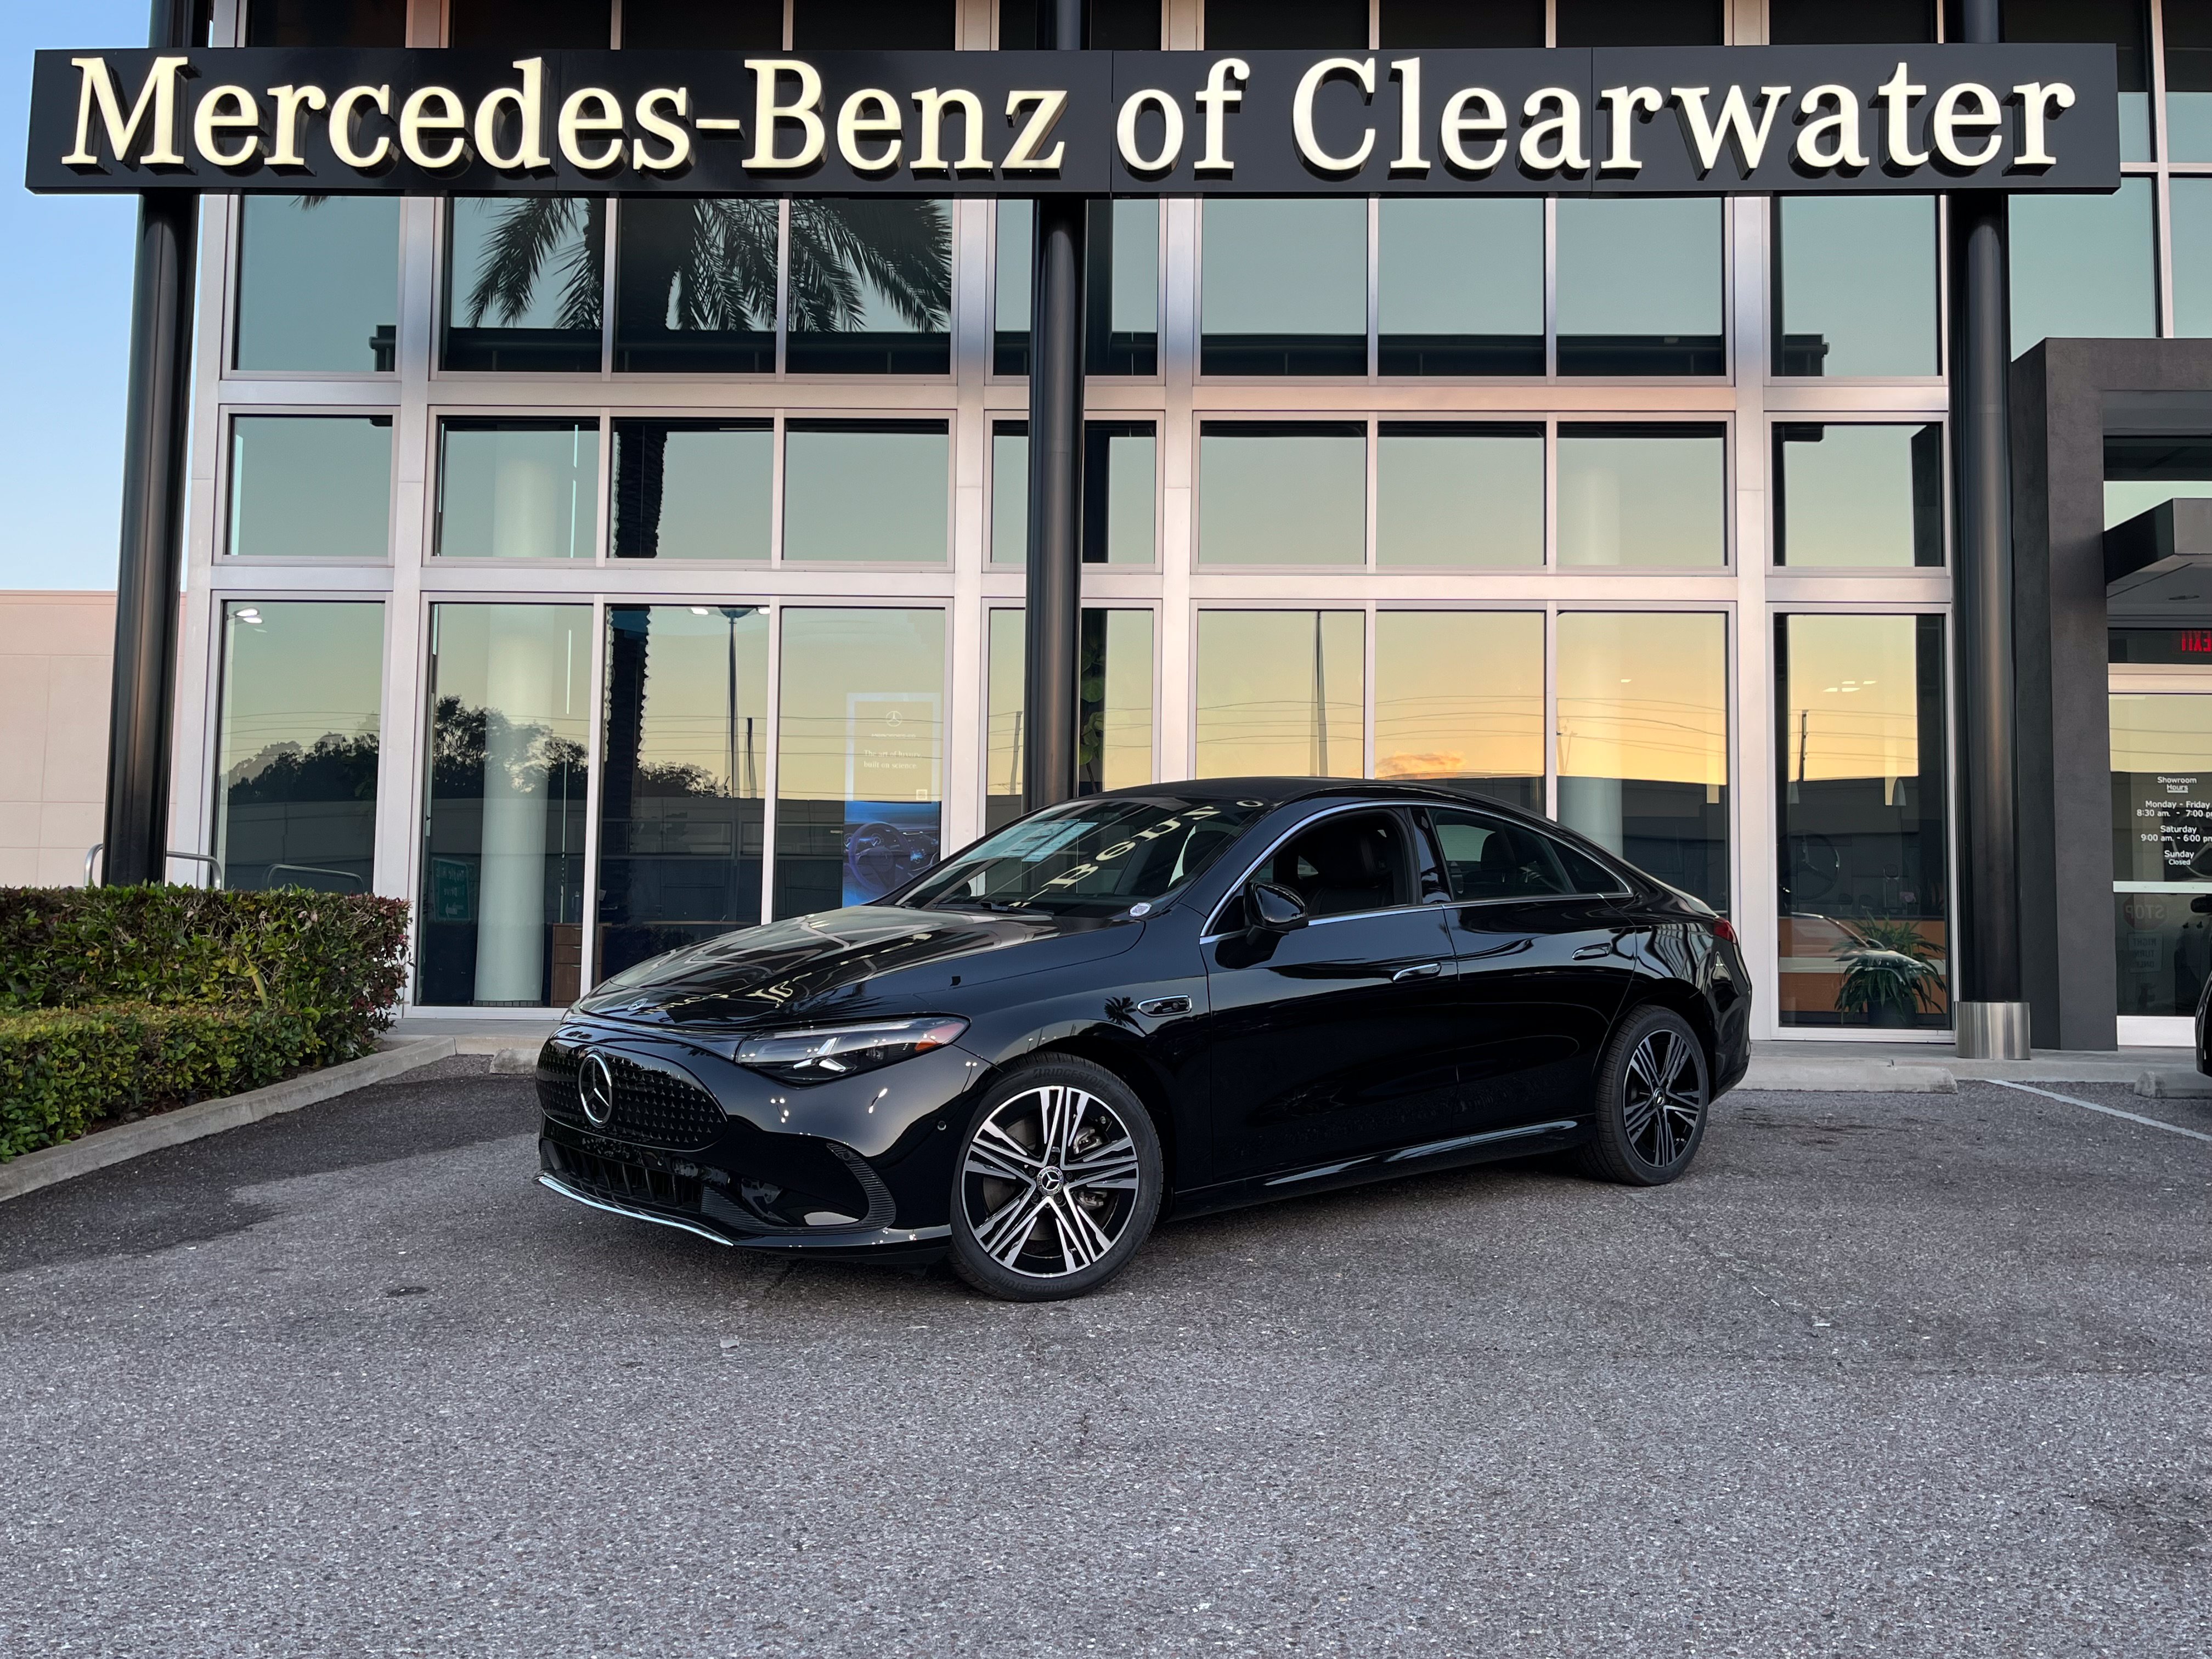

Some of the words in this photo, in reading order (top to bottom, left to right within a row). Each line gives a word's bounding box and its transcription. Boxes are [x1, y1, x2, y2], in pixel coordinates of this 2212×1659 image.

[61, 56, 1068, 171] Mercedes-Benz
[1116, 58, 1250, 171] of
[1292, 57, 2076, 171] Clearwater
[2145, 800, 2177, 809] Monday
[2186, 800, 2210, 810] Friday
[2160, 825, 2197, 834] Saturday
[2183, 834, 2201, 842] 6:00
[2164, 850, 2194, 859] Sunday
[1032, 1067, 1111, 1092] BRIDGESTONE
